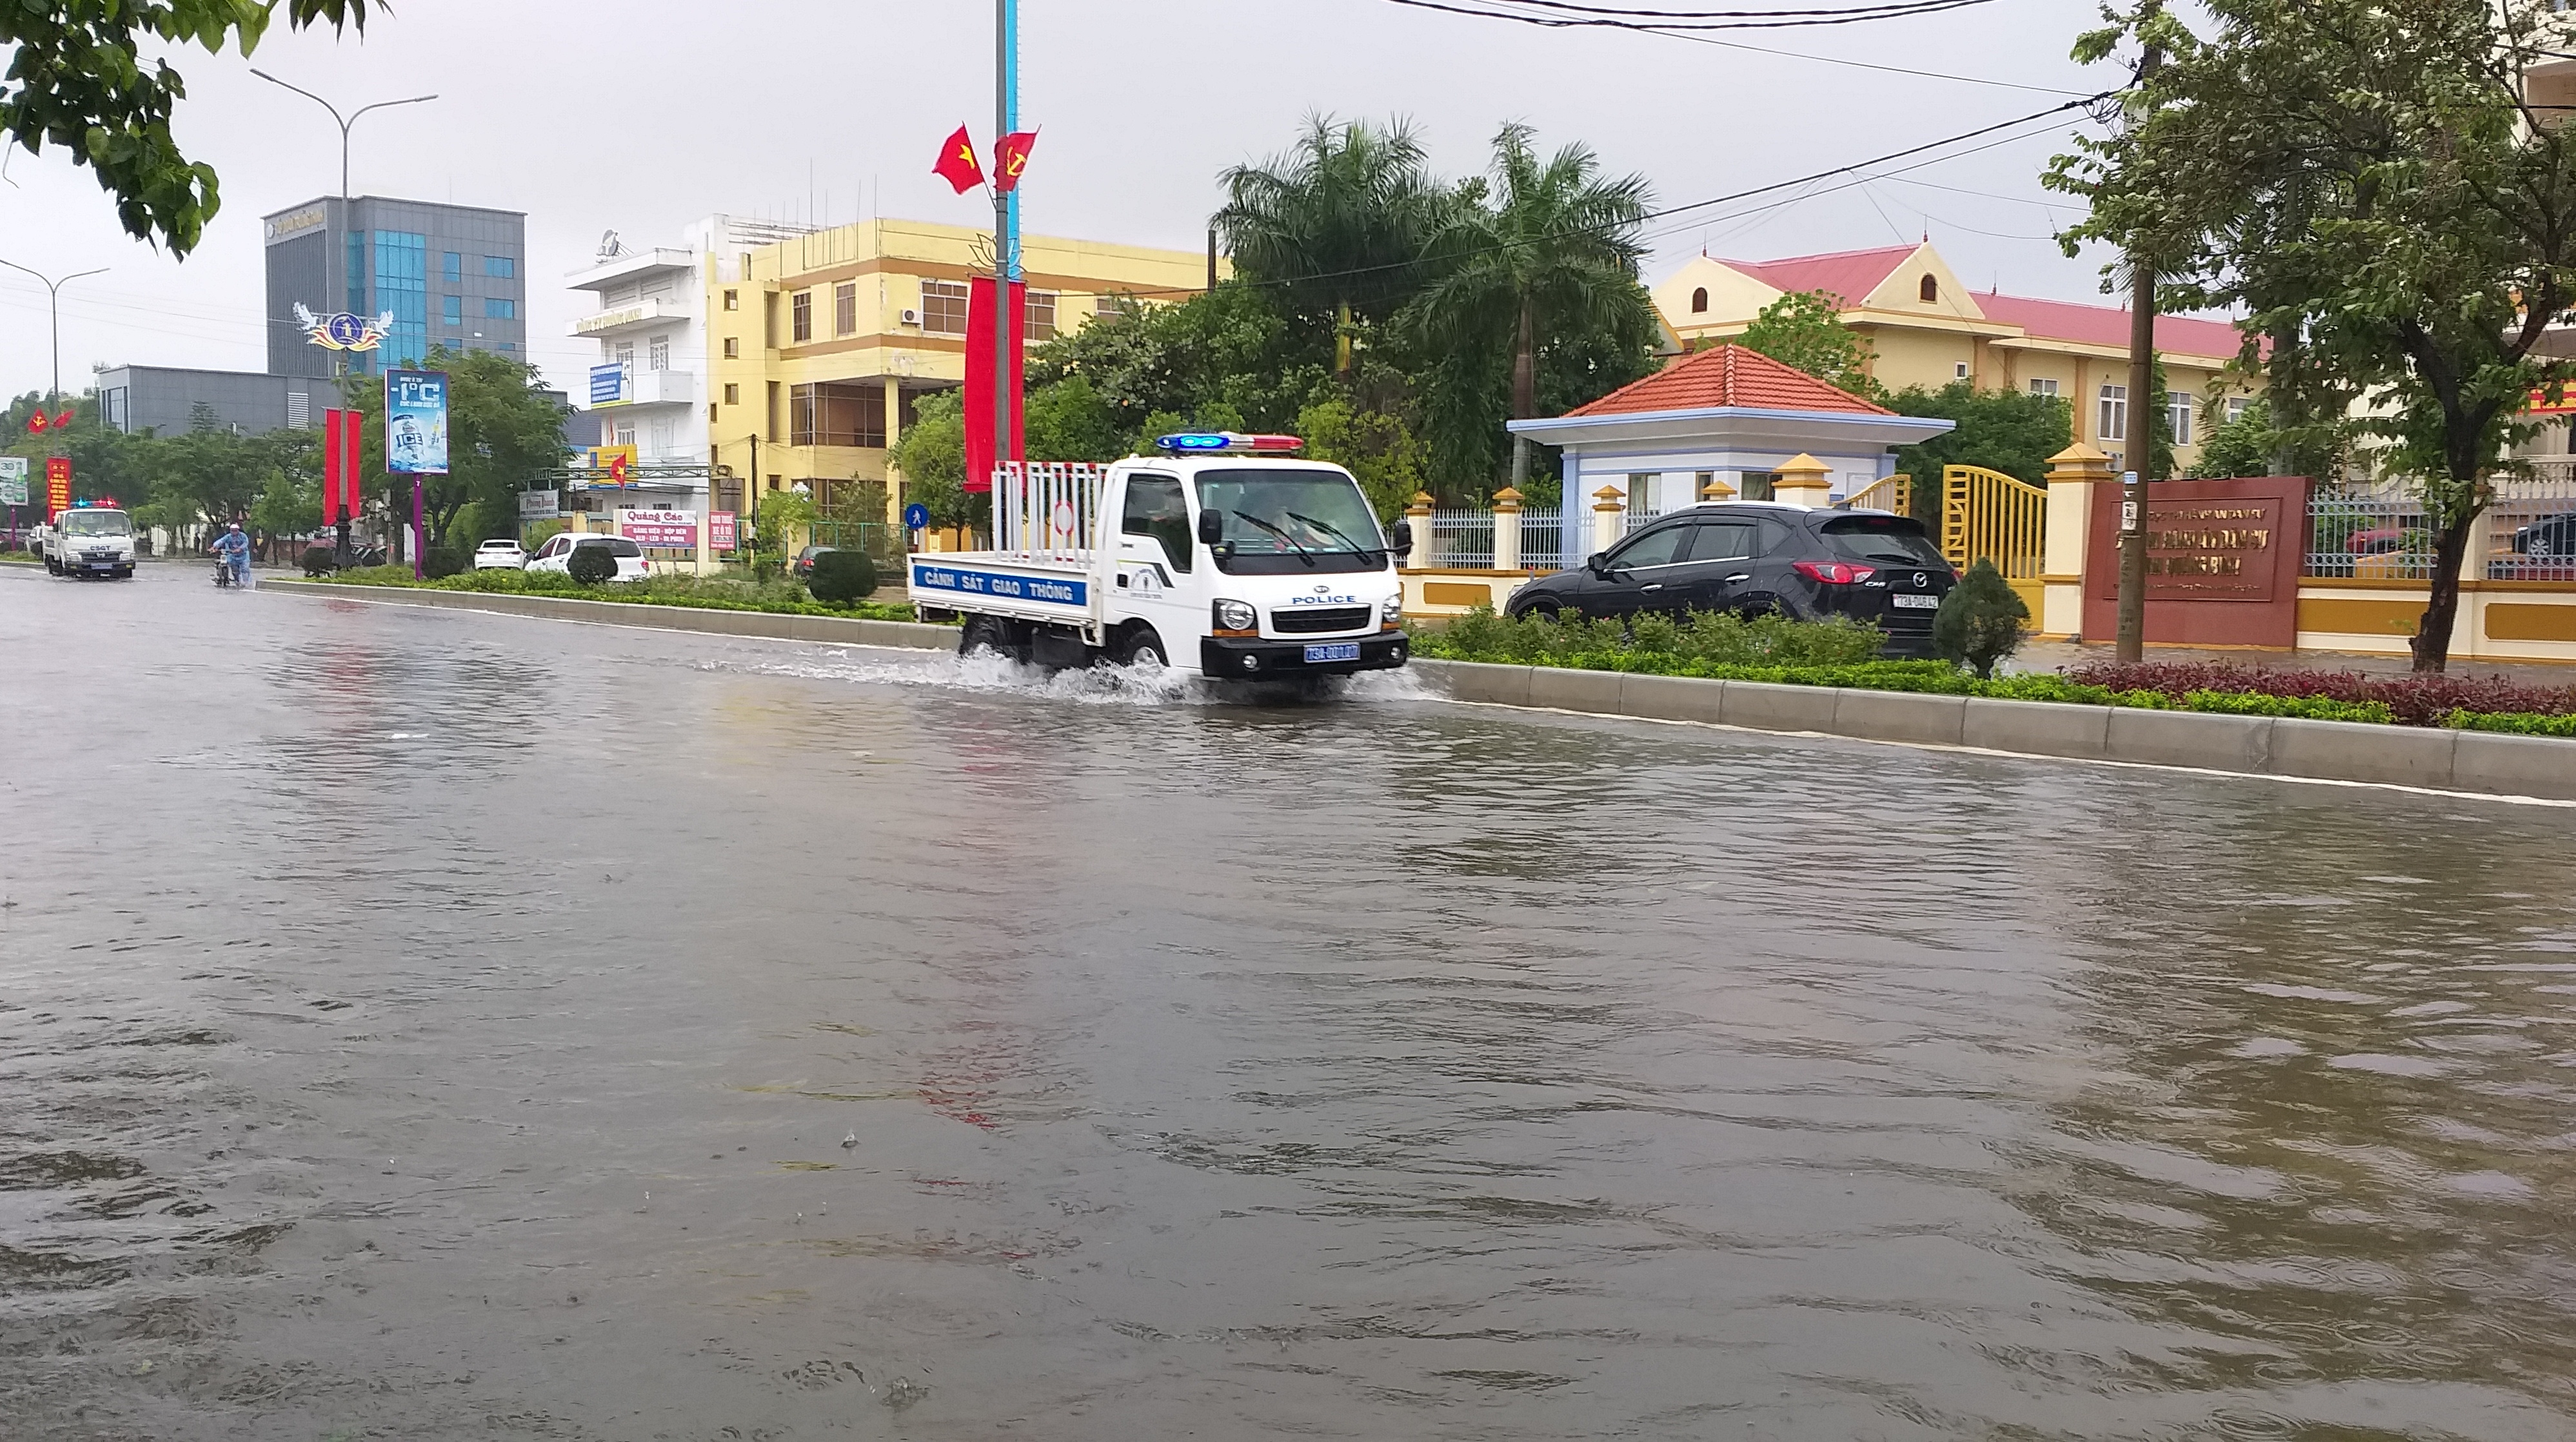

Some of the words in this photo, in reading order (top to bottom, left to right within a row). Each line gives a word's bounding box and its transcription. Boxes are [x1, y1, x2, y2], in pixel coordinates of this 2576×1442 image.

[397, 433, 422, 447] ICE
[628, 511, 661, 522] Quảng
[664, 512, 683, 521] Cáo
[924, 568, 955, 588] CẢNH
[962, 573, 984, 591] SÁT
[991, 578, 1021, 596] GIAO
[1028, 581, 1073, 601] THÔNG
[1292, 595, 1356, 604] POLICE
